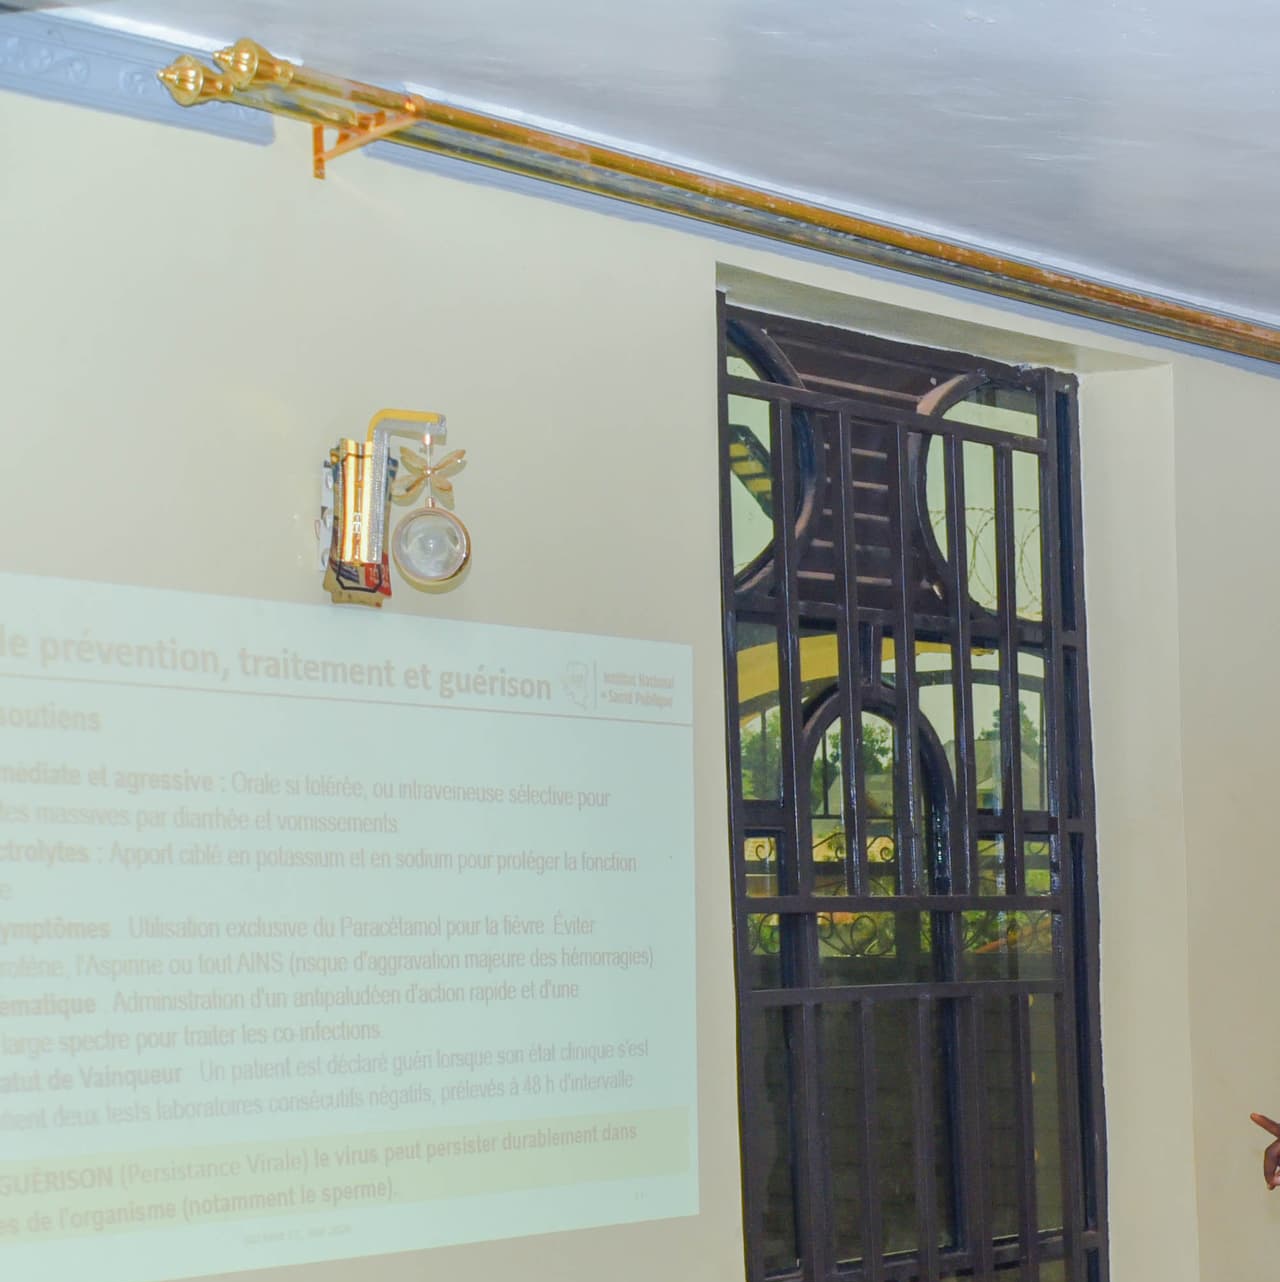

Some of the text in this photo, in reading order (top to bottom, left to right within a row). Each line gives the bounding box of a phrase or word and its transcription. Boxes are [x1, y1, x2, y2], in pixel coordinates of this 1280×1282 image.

[40, 628, 231, 681] prévention,
[238, 647, 394, 688] traitement
[404, 663, 431, 690] et
[440, 663, 551, 700] guérison
[88, 763, 107, 787] et
[114, 768, 213, 795] agressive
[232, 770, 280, 794] Orale
[285, 774, 300, 794] si
[373, 784, 393, 800] ou
[400, 779, 503, 802] intraveineuse
[509, 784, 574, 807] sélective
[578, 790, 610, 811] pour
[136, 809, 166, 832] par
[255, 809, 272, 831] et
[109, 841, 173, 872] Apport
[179, 843, 221, 864] ciblé
[227, 848, 250, 865] en
[256, 845, 345, 872] potassium
[350, 850, 365, 868] et
[370, 853, 391, 868] en
[396, 849, 453, 870] sodium
[457, 853, 492, 876] pour
[498, 849, 560, 878] protéger
[564, 852, 578, 871] la
[582, 851, 638, 872] fonction
[128, 913, 220, 939] Utilisation
[225, 914, 311, 939] exclusive
[313, 915, 335, 938] du
[340, 914, 441, 937] Paracétamol
[446, 917, 481, 940] pour
[485, 915, 498, 936] la
[552, 908, 596, 936] Éviter
[169, 957, 192, 976] ou
[199, 953, 233, 976] tout
[236, 951, 282, 974] AINS
[290, 952, 346, 977] (risque
[354, 950, 460, 979] d'aggravation
[464, 950, 525, 974] majeure
[530, 946, 557, 967] des
[112, 989, 244, 1015] Administration
[250, 986, 287, 1008] d'un
[294, 983, 400, 1012] antipaludéen
[405, 983, 464, 1003] d'action
[470, 981, 517, 1006] rapide
[521, 983, 535, 1000] et
[539, 979, 579, 1000] d'une
[58, 1028, 129, 1056] spectre
[136, 1030, 178, 1055] pour
[184, 1024, 236, 1048] traiter
[242, 1024, 266, 1045] les
[48, 1067, 73, 1091] de
[79, 1063, 184, 1092] Vainqueur
[200, 1059, 225, 1082] Un
[231, 1055, 291, 1084] patient
[296, 1057, 321, 1077] est
[328, 1053, 388, 1076] déclaré
[393, 1053, 432, 1076] guéri
[437, 1050, 492, 1073] lorsque
[496, 1050, 524, 1065] son
[528, 1042, 556, 1062] état
[560, 1042, 614, 1066] clinique
[617, 1040, 649, 1058] s'est
[107, 1102, 150, 1126] tests
[157, 1096, 263, 1121] laboratoires
[269, 1088, 364, 1112] consécutifs
[369, 1082, 437, 1111] négatifs,
[440, 1078, 504, 1105] prélevés
[510, 1077, 519, 1097] à
[523, 1074, 542, 1096] 48
[546, 1075, 555, 1094] h
[559, 1070, 634, 1093] d'intervalle
[120, 1157, 240, 1190] (Persistance
[246, 1148, 310, 1176] Virale)
[314, 1148, 329, 1168] le
[335, 1143, 378, 1168] virus
[384, 1141, 422, 1167] peut
[426, 1133, 496, 1164] persister
[503, 1124, 598, 1152] durablement
[602, 1120, 637, 1142] dans
[27, 1210, 54, 1232] de
[59, 1199, 177, 1231] l'organisme
[183, 1186, 295, 1223] (notamment
[301, 1183, 316, 1205] le
